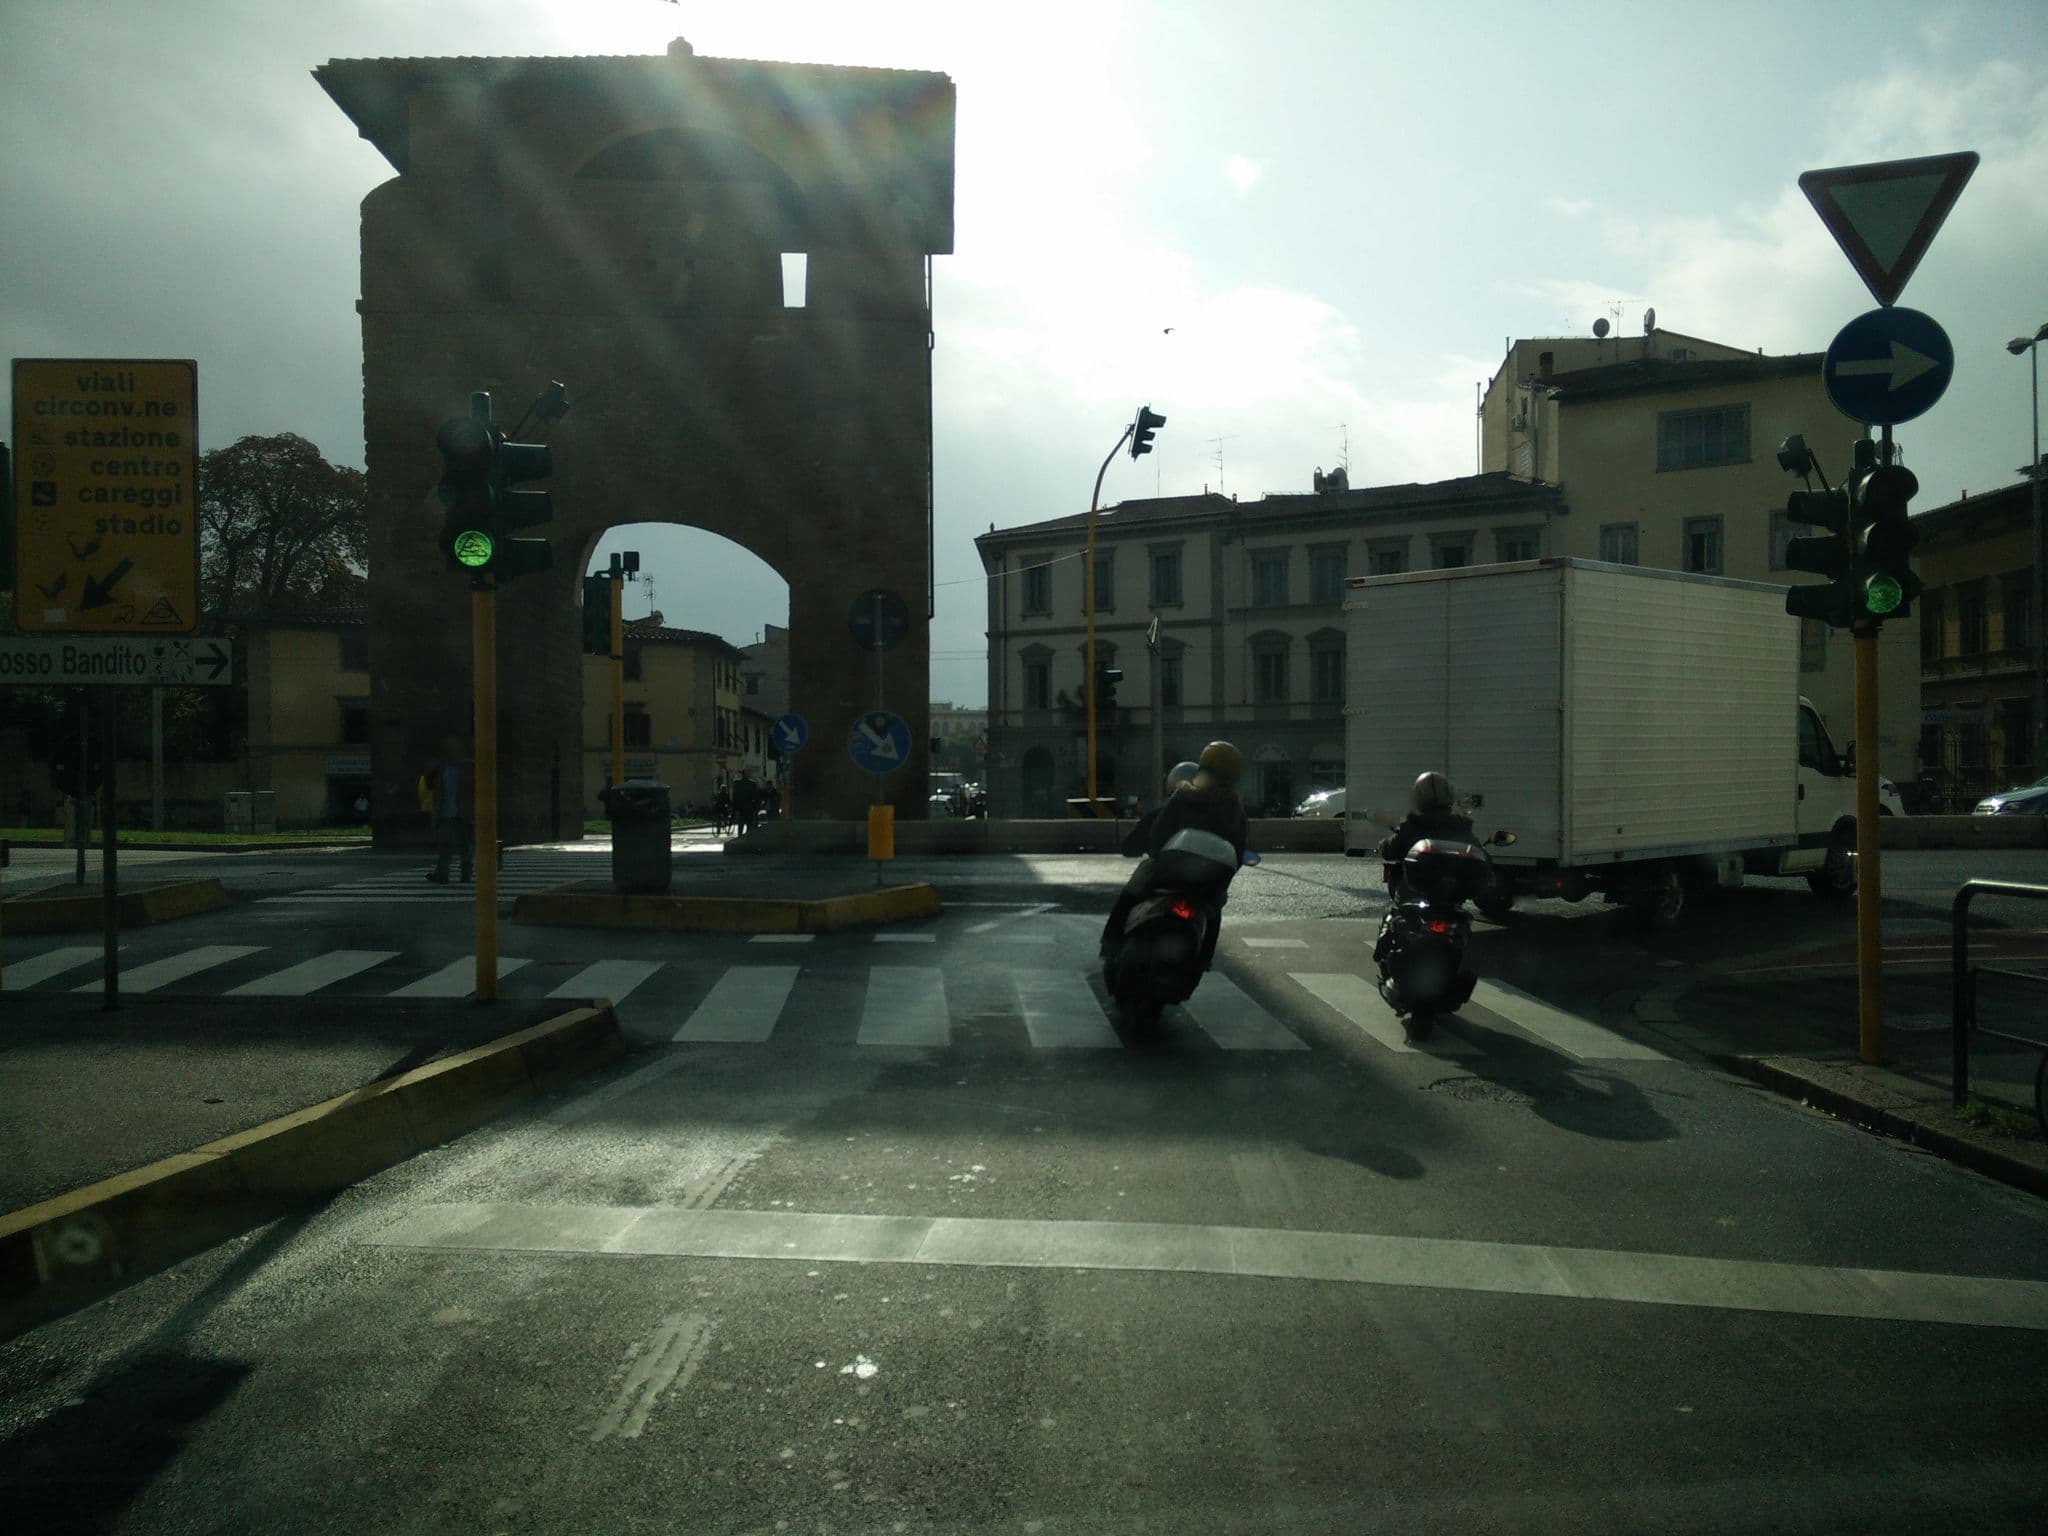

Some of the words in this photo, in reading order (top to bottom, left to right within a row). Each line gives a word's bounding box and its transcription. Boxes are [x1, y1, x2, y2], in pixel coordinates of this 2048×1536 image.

[76, 372, 136, 393] viali
[33, 396, 178, 417] circonv.ne
[64, 427, 180, 448] stazione
[90, 456, 181, 476] centro
[78, 483, 182, 508] careggi
[95, 514, 182, 536] stadio
[62, 645, 147, 675] Bandito
